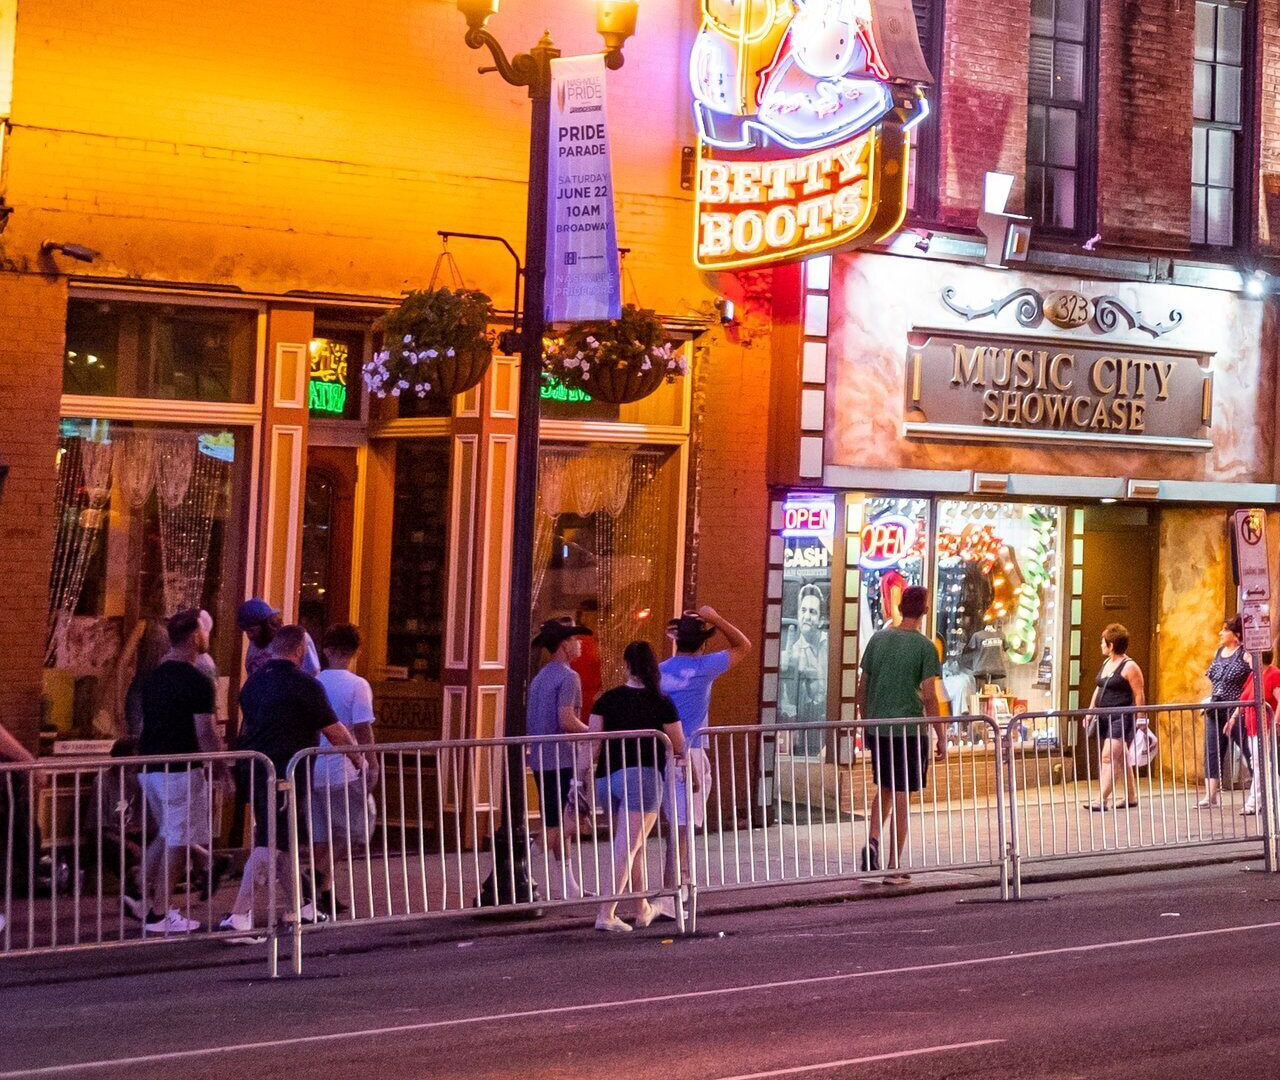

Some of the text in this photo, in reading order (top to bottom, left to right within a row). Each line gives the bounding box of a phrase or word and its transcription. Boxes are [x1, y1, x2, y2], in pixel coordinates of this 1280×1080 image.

[567, 85, 602, 100] PRIDE
[558, 124, 605, 142] PRIDE
[558, 144, 606, 158] PARADE
[558, 173, 608, 185] SATURDAY
[699, 133, 870, 204] BETTY
[557, 186, 608, 199] JUNE 22
[566, 205, 601, 218] 10AM
[699, 181, 868, 256] BOOTS
[556, 222, 610, 234] BROADWAY
[1060, 294, 1088, 323] 323
[950, 343, 1178, 401] MUSIC CITY
[982, 389, 1146, 432] SHOWCASE
[785, 507, 831, 530] OPEN
[861, 524, 908, 558] OPEN
[784, 547, 828, 568] CASH
